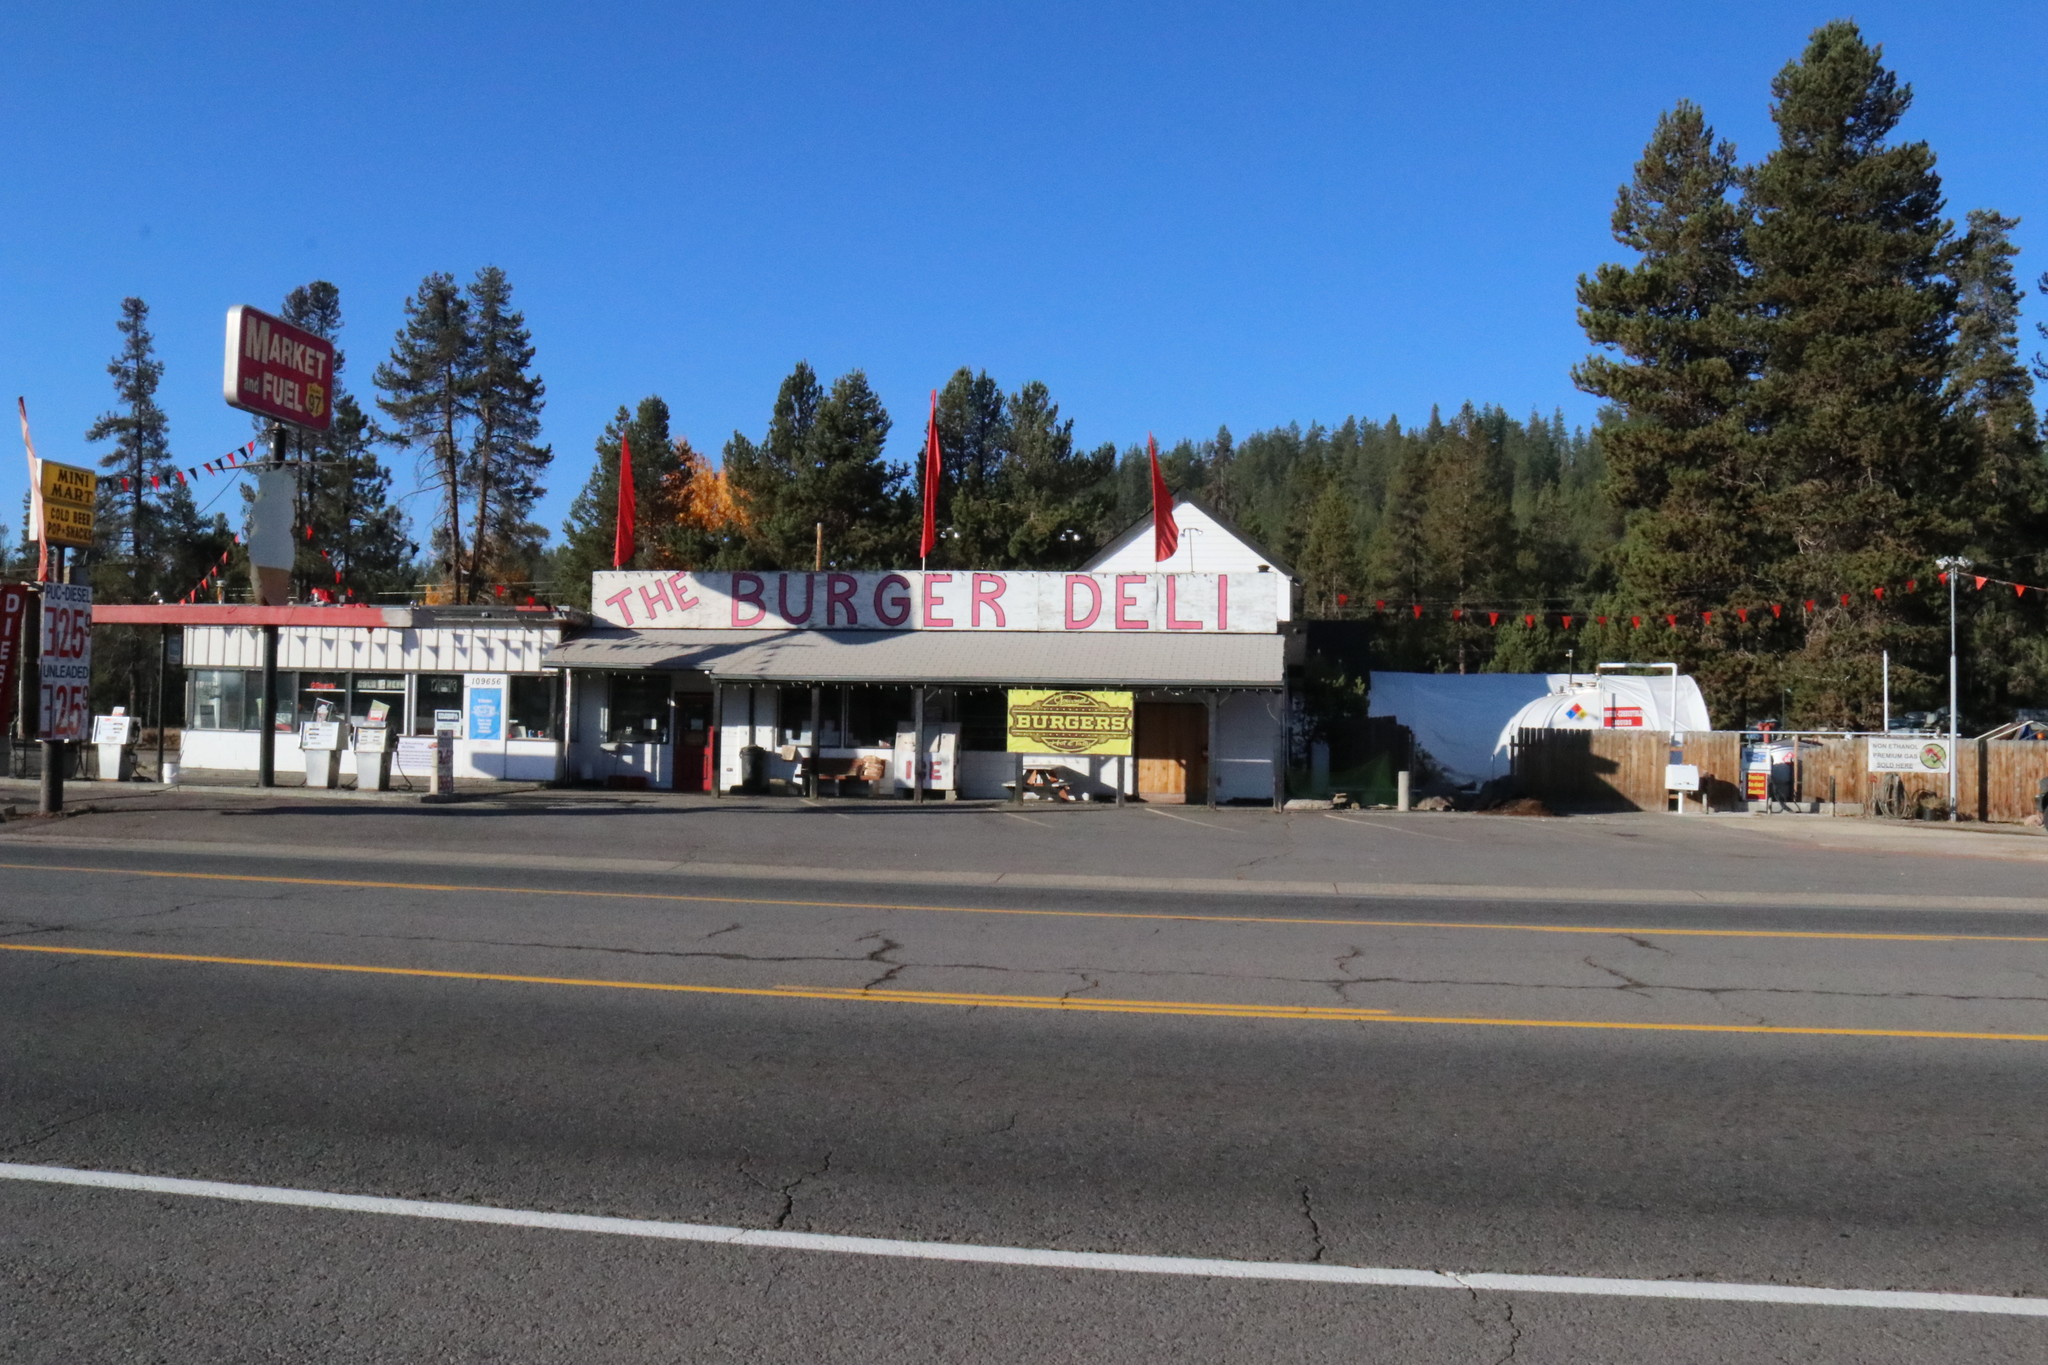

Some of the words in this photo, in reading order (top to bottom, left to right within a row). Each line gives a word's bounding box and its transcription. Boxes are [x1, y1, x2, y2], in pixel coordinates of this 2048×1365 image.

[245, 315, 326, 380] MARKET
[244, 377, 259, 394] and
[263, 371, 303, 413] FUEL
[308, 393, 321, 414] 97
[57, 469, 89, 488] MINI
[52, 483, 93, 503] MART
[50, 507, 70, 522] COLD
[73, 511, 91, 526] BEER
[605, 571, 699, 627] THE
[731, 572, 1007, 628] BURGER
[1065, 574, 1228, 630] DELI
[43, 665, 89, 679] UNLEADED
[471, 677, 501, 685] 109656
[1016, 715, 1126, 730] BURGERS
